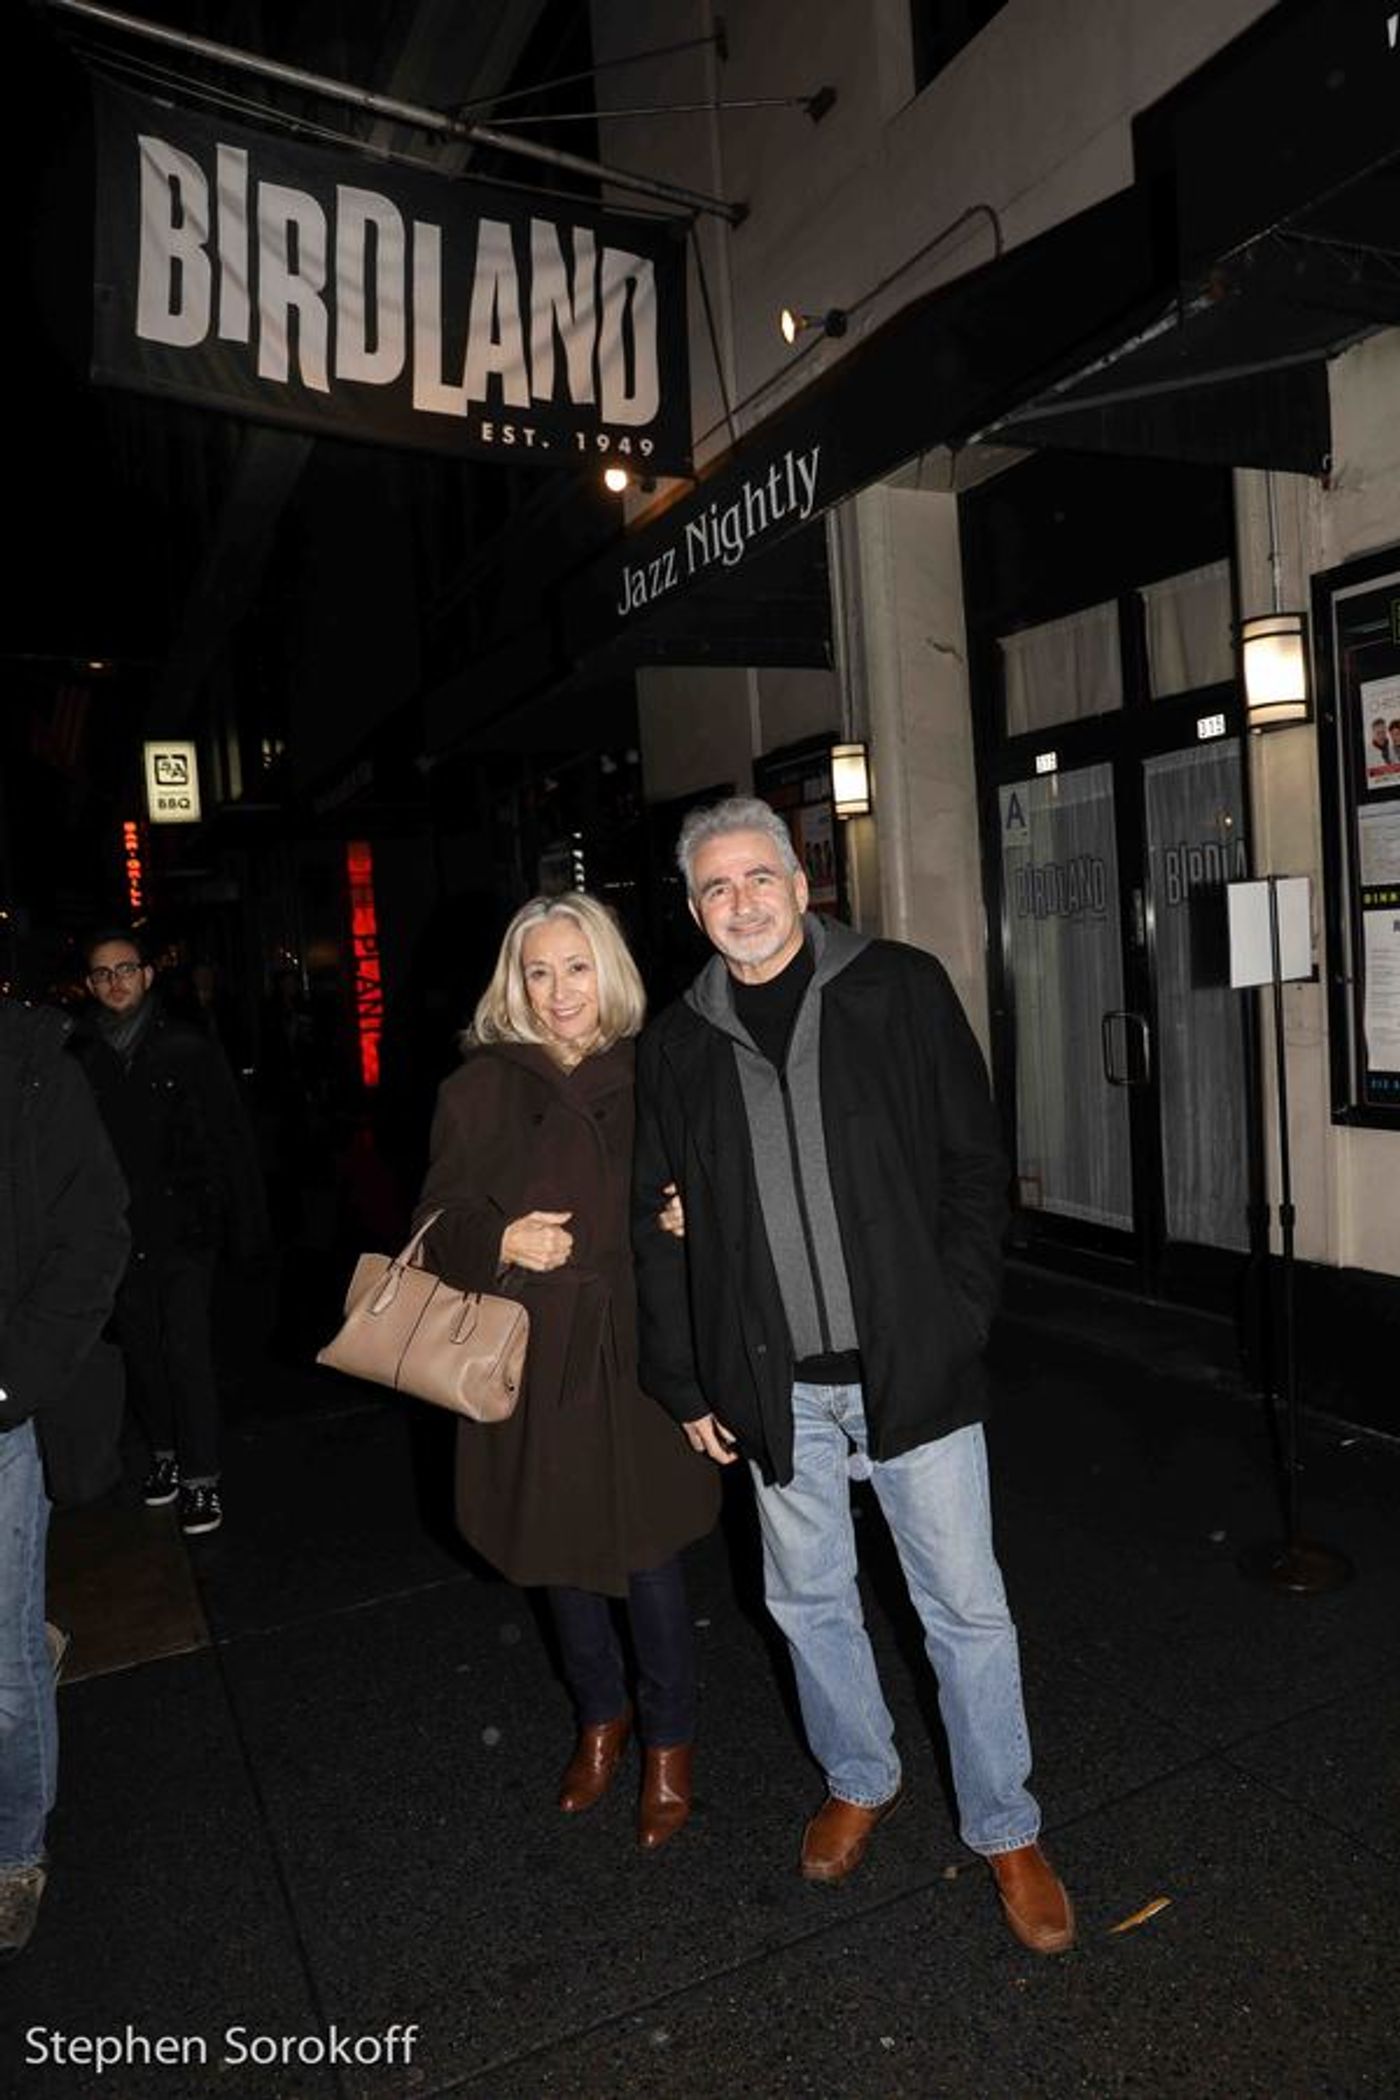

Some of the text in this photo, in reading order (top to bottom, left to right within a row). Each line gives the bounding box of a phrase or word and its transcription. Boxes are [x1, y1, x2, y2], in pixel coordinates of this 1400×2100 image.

[136, 134, 661, 428] BIRDLAND
[481, 421, 656, 457] EST. 1949
[617, 445, 821, 616] Jazz Nightly
[1006, 791, 1027, 829] A
[1016, 853, 1107, 921] BIRDLAND
